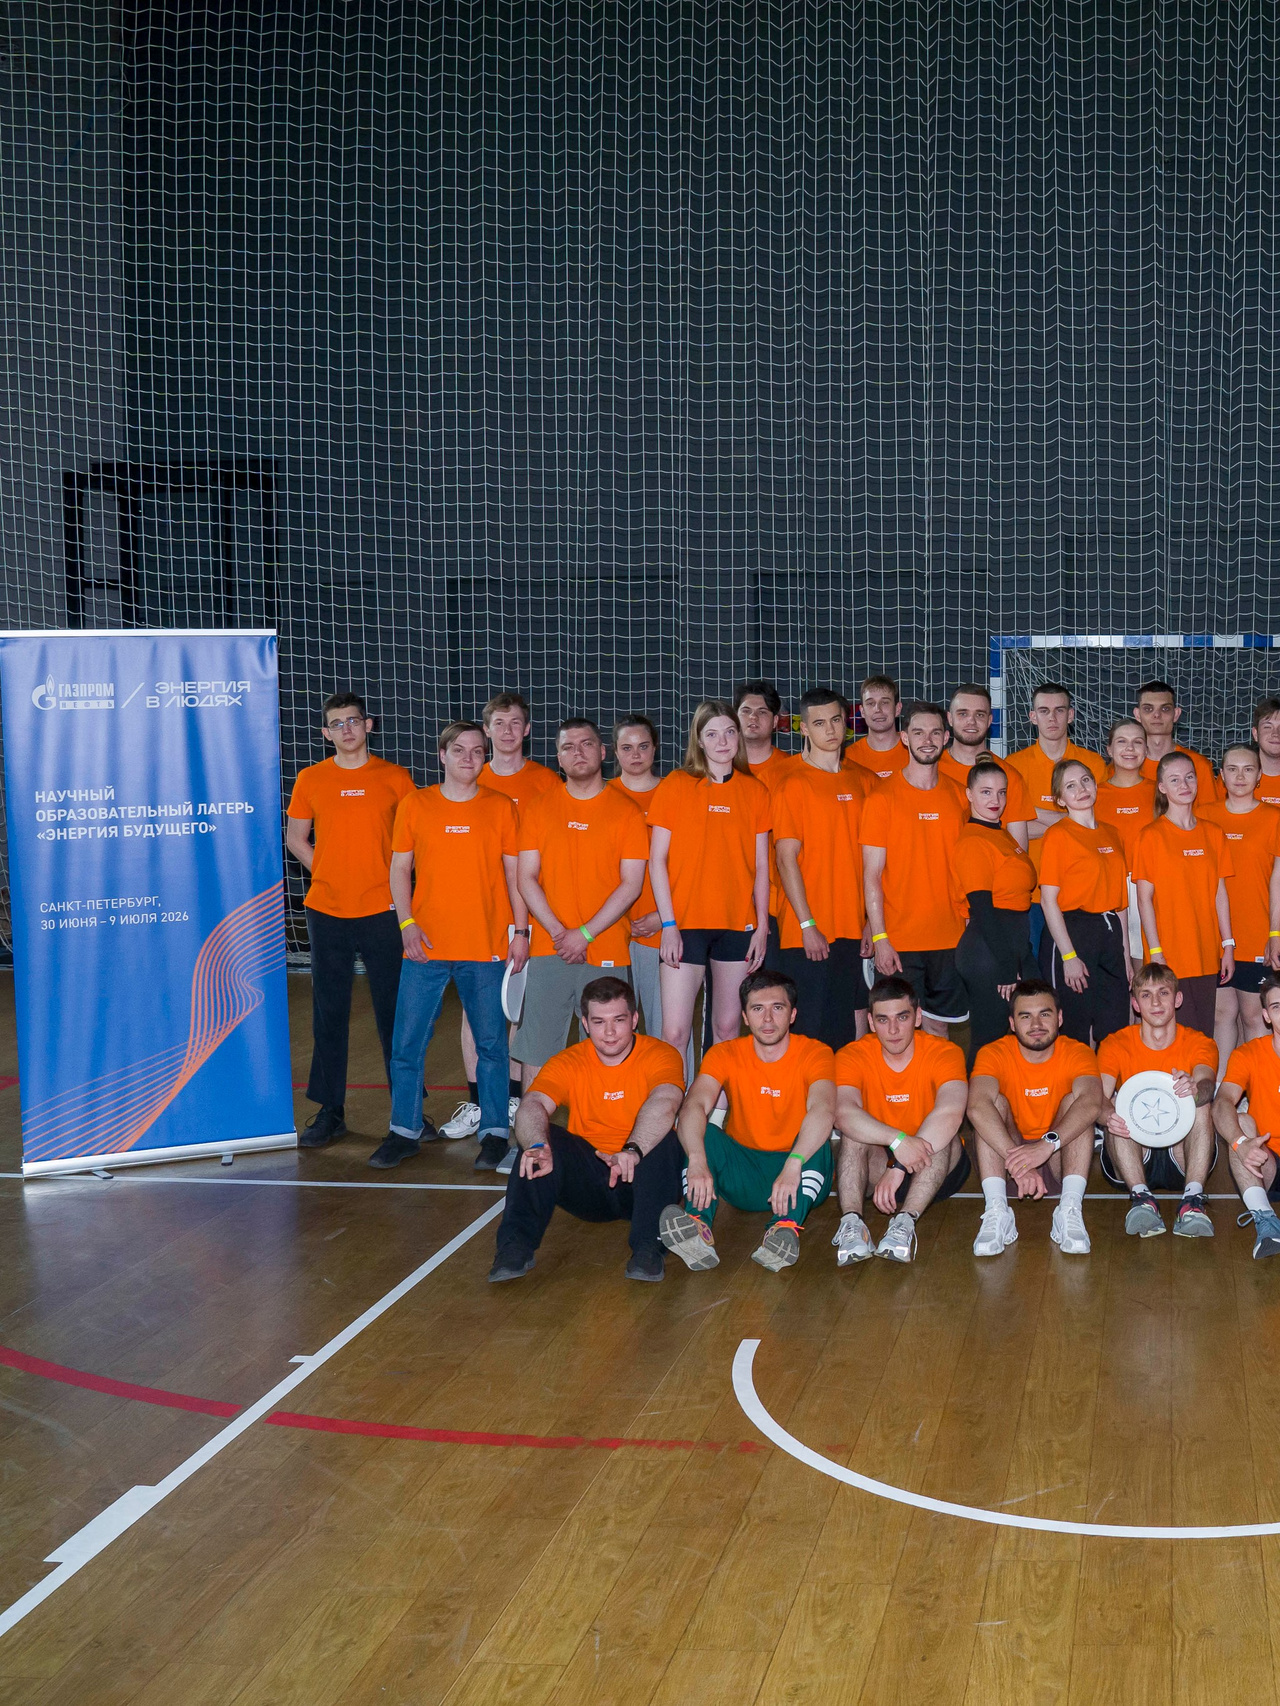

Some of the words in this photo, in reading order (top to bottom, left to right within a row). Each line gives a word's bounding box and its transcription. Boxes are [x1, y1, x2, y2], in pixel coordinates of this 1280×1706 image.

[59, 683, 114, 697] ГАЗПРОМ
[156, 681, 250, 693] ЭНЕРГИЯ
[61, 700, 113, 708] НЕФТЬ
[146, 696, 160, 708] В
[165, 695, 242, 707] ЛЮДЯХ
[35, 786, 115, 804] НАУЧНЫЙ
[36, 802, 193, 822] ОБРАЗОВАТЕЛЬНЫЙ
[197, 802, 254, 815] ЛАГЕРЬ
[37, 826, 118, 840] «ЭНЕРГИЯ
[124, 822, 217, 838] БУДУЩЕГО»
[40, 896, 161, 912] САНКТ-ПЕТЕРБУРГ,
[41, 920, 55, 930] 30
[60, 917, 97, 928] ИЮНЯ
[110, 916, 116, 925] 9
[120, 913, 157, 924] ИЮЛЯ
[161, 911, 188, 922] 2026
